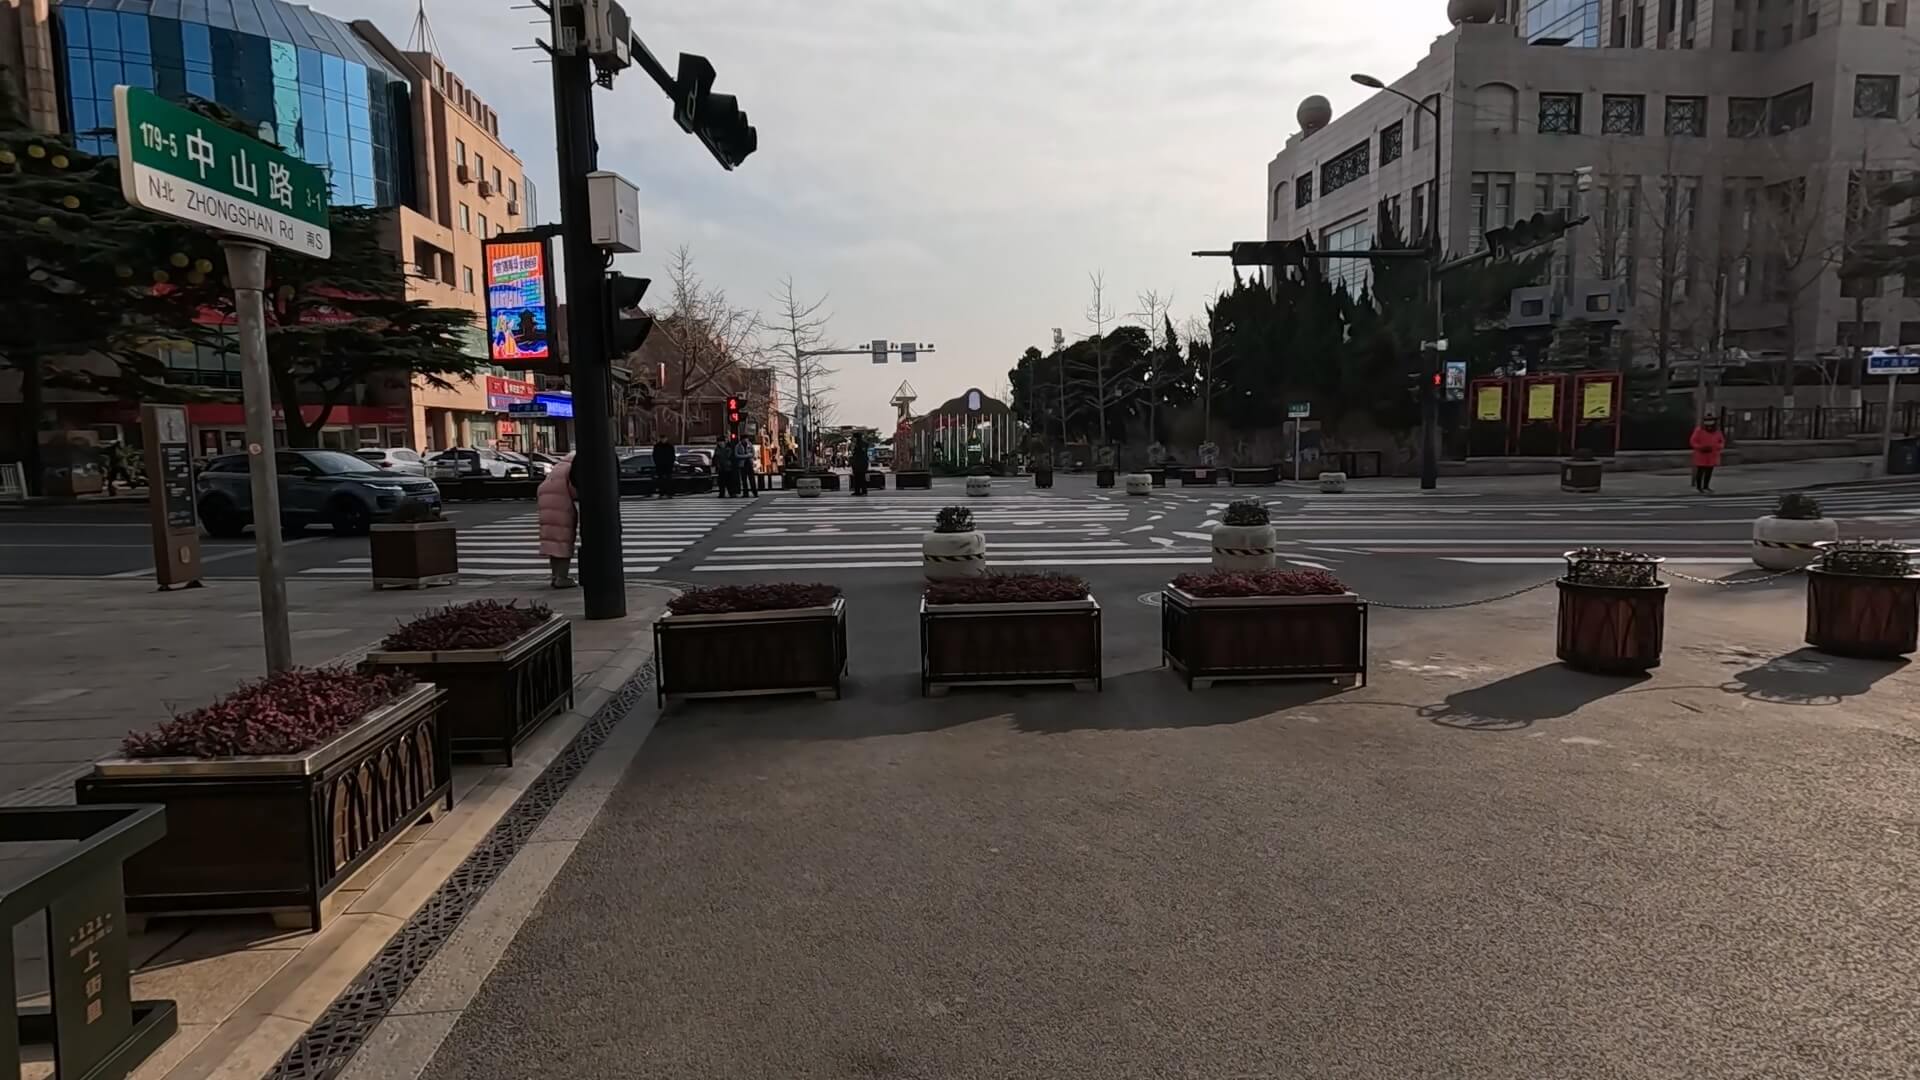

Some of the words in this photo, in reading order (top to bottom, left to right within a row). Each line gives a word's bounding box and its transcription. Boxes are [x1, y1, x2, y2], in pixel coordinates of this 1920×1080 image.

[139, 122, 178, 158] 179-5
[185, 128, 294, 210] 中山路
[305, 187, 322, 212] 3-1
[186, 189, 274, 235] ZHONGSHAN
[279, 220, 295, 241] Rd
